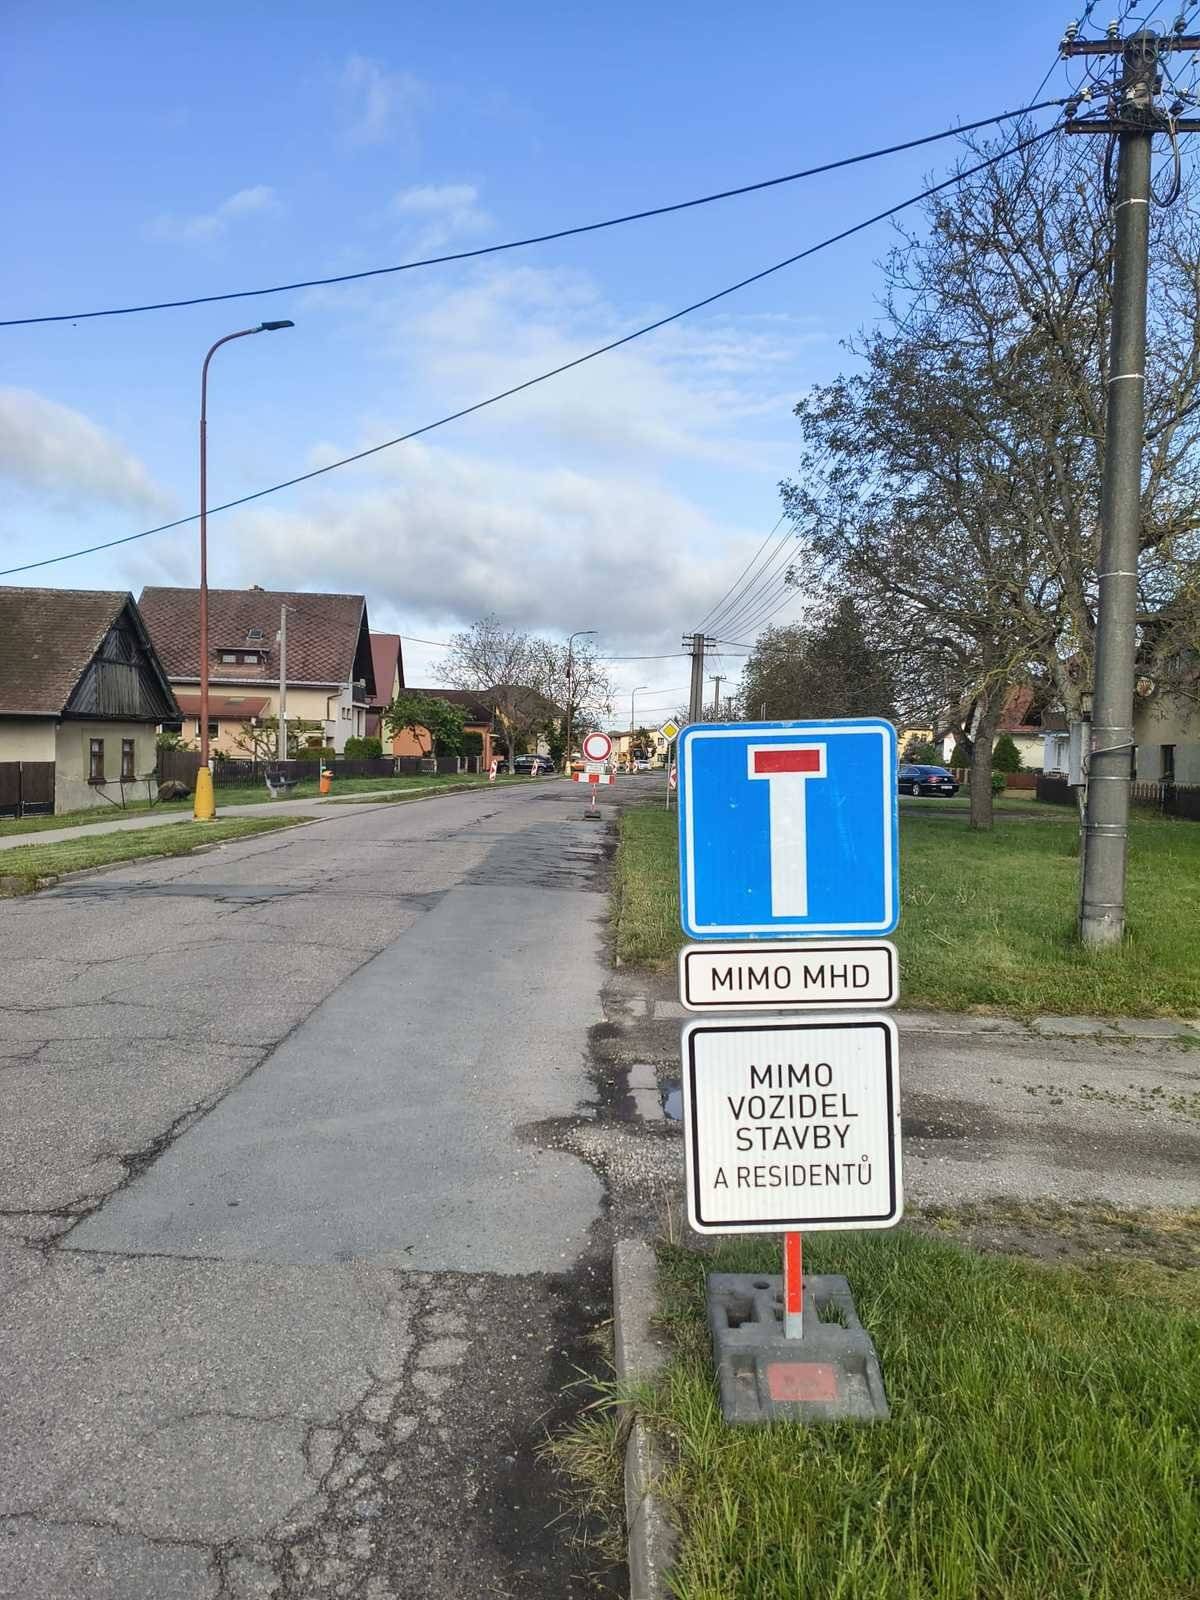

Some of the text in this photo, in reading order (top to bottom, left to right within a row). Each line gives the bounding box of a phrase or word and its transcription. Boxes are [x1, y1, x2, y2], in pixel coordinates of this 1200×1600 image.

[711, 964, 870, 991] MIMO MHD
[750, 1063, 833, 1089] MIMO
[728, 1093, 858, 1120] VOZIDEL
[736, 1124, 850, 1151] STAVBY
[713, 1154, 872, 1189] A RESIDENTŮ
